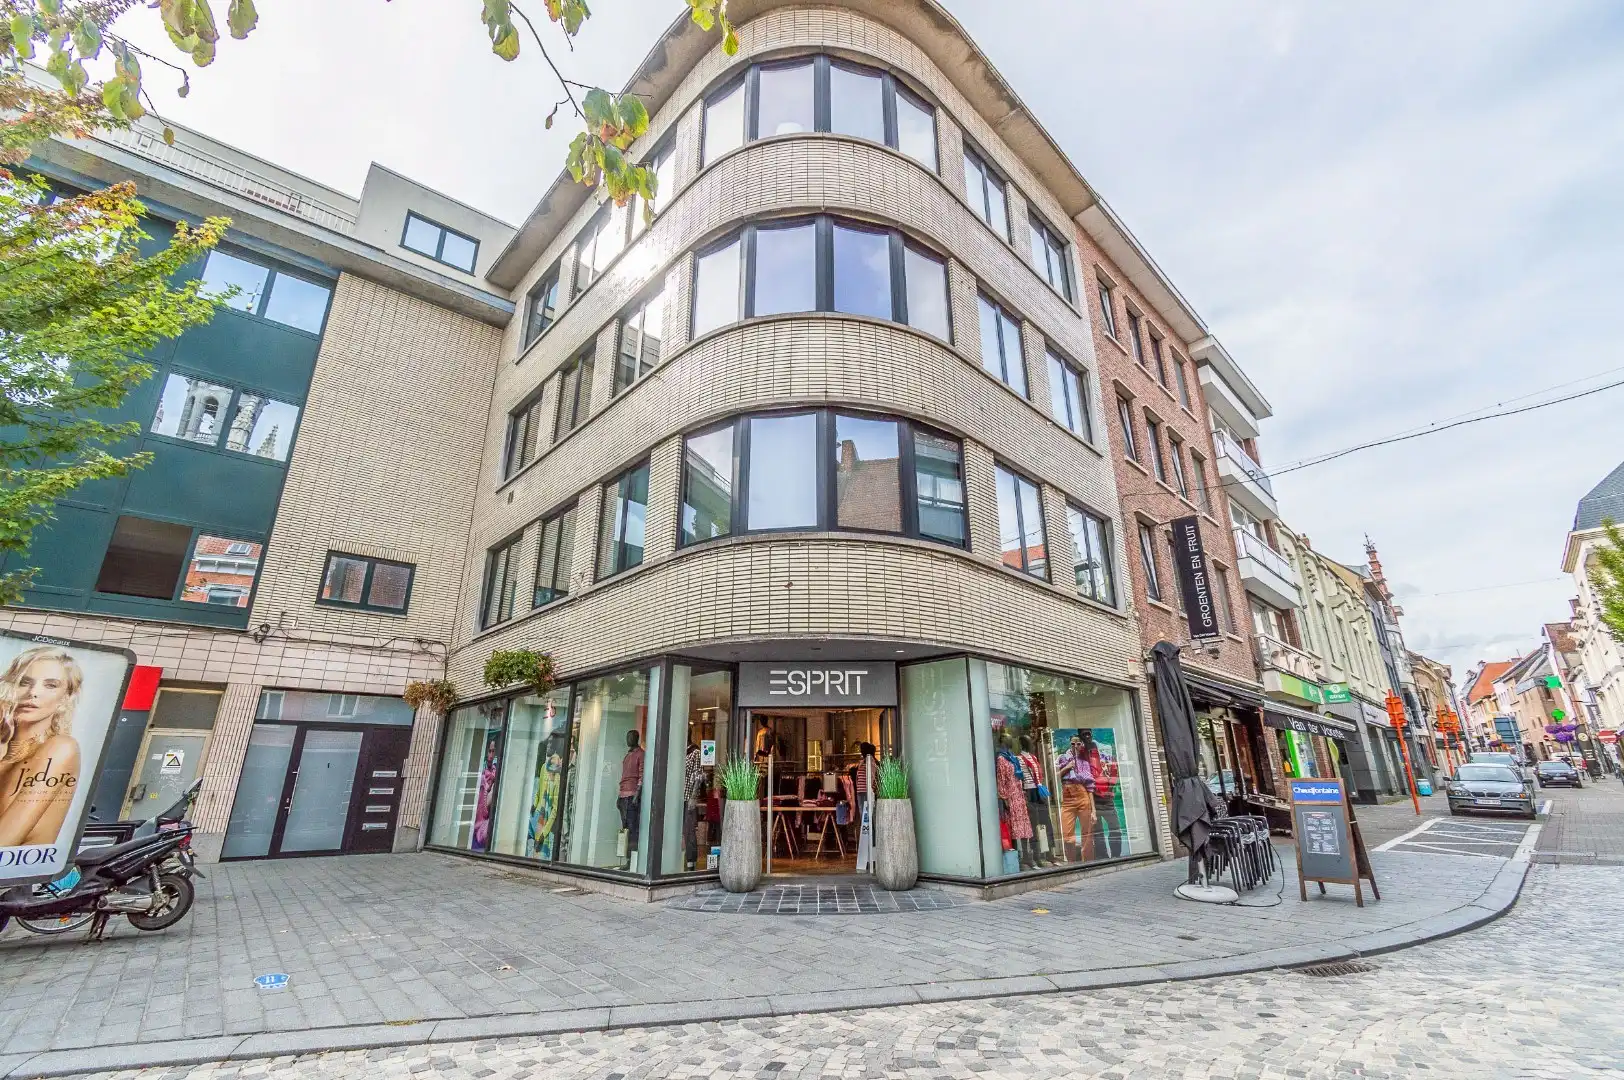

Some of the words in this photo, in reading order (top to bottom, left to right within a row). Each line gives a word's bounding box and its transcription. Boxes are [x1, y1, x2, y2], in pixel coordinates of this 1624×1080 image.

[1184, 524, 1199, 553] FRUIT
[1191, 555, 1202, 569] EN
[1194, 572, 1213, 627] GROENTEN
[31, 635, 71, 647] JCDecaux
[769, 670, 868, 695] ESPRIT
[1286, 716, 1306, 731] Van
[1293, 786, 1339, 795] Chaudfontaine
[0, 847, 57, 867] DIOR
